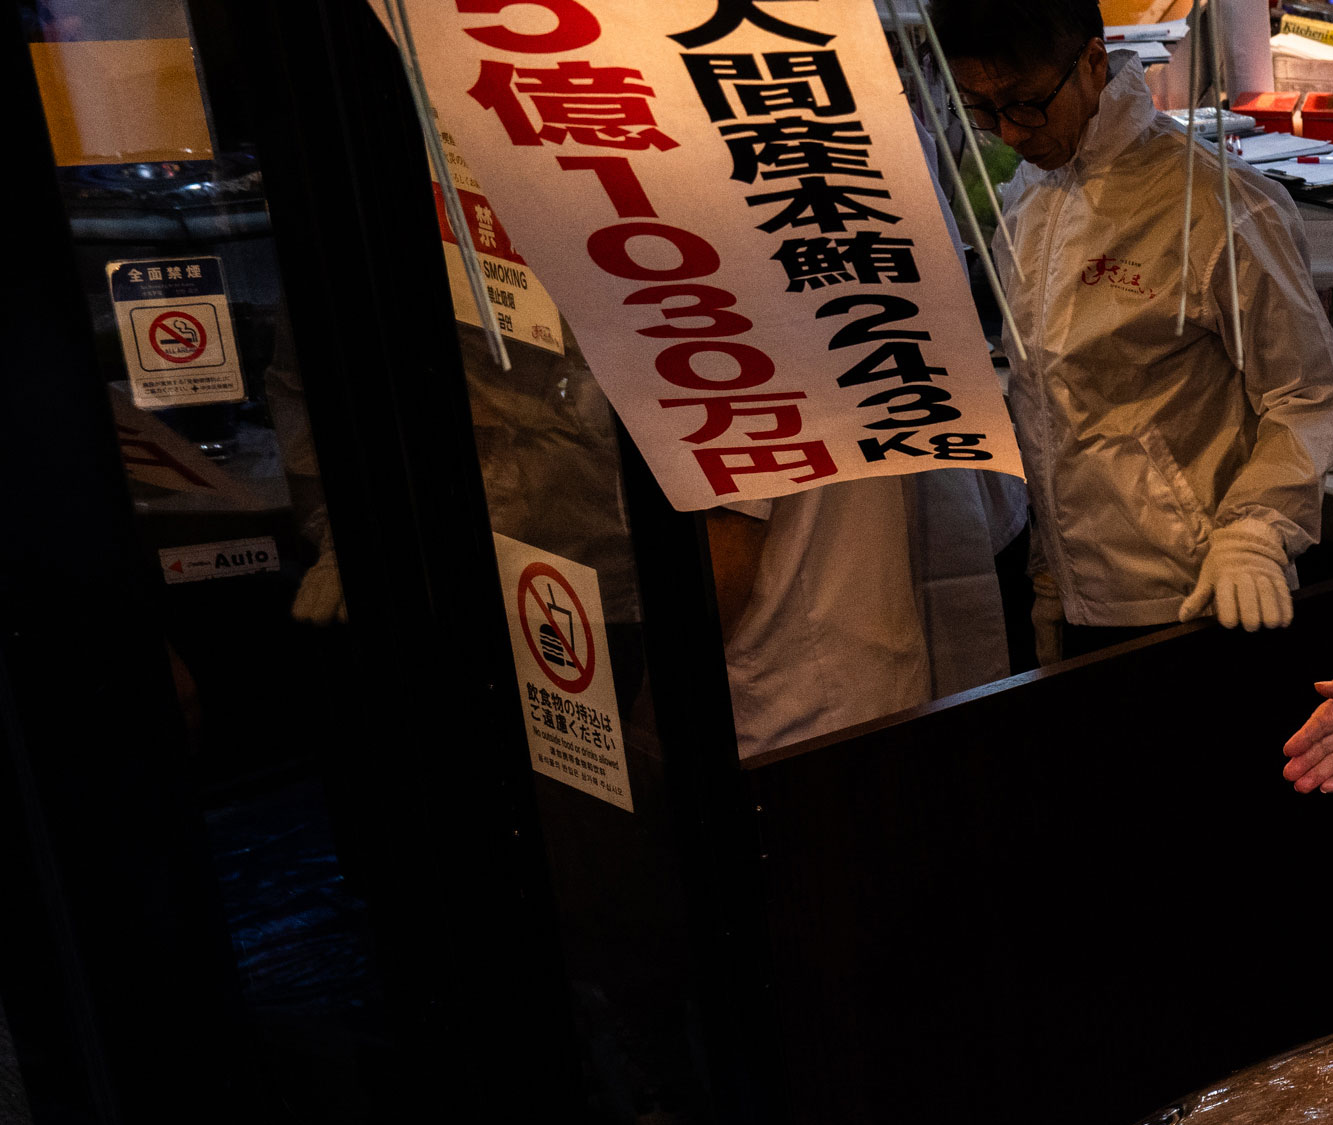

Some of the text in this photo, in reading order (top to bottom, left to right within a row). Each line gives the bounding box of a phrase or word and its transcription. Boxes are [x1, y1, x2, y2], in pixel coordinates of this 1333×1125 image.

[128, 264, 203, 283] 全面禁煙
[484, 260, 528, 290] SMOKING
[215, 550, 269, 569] Auto
[527, 682, 613, 733] 飲食物の持込は
[531, 703, 616, 751] ご遠慮ください
